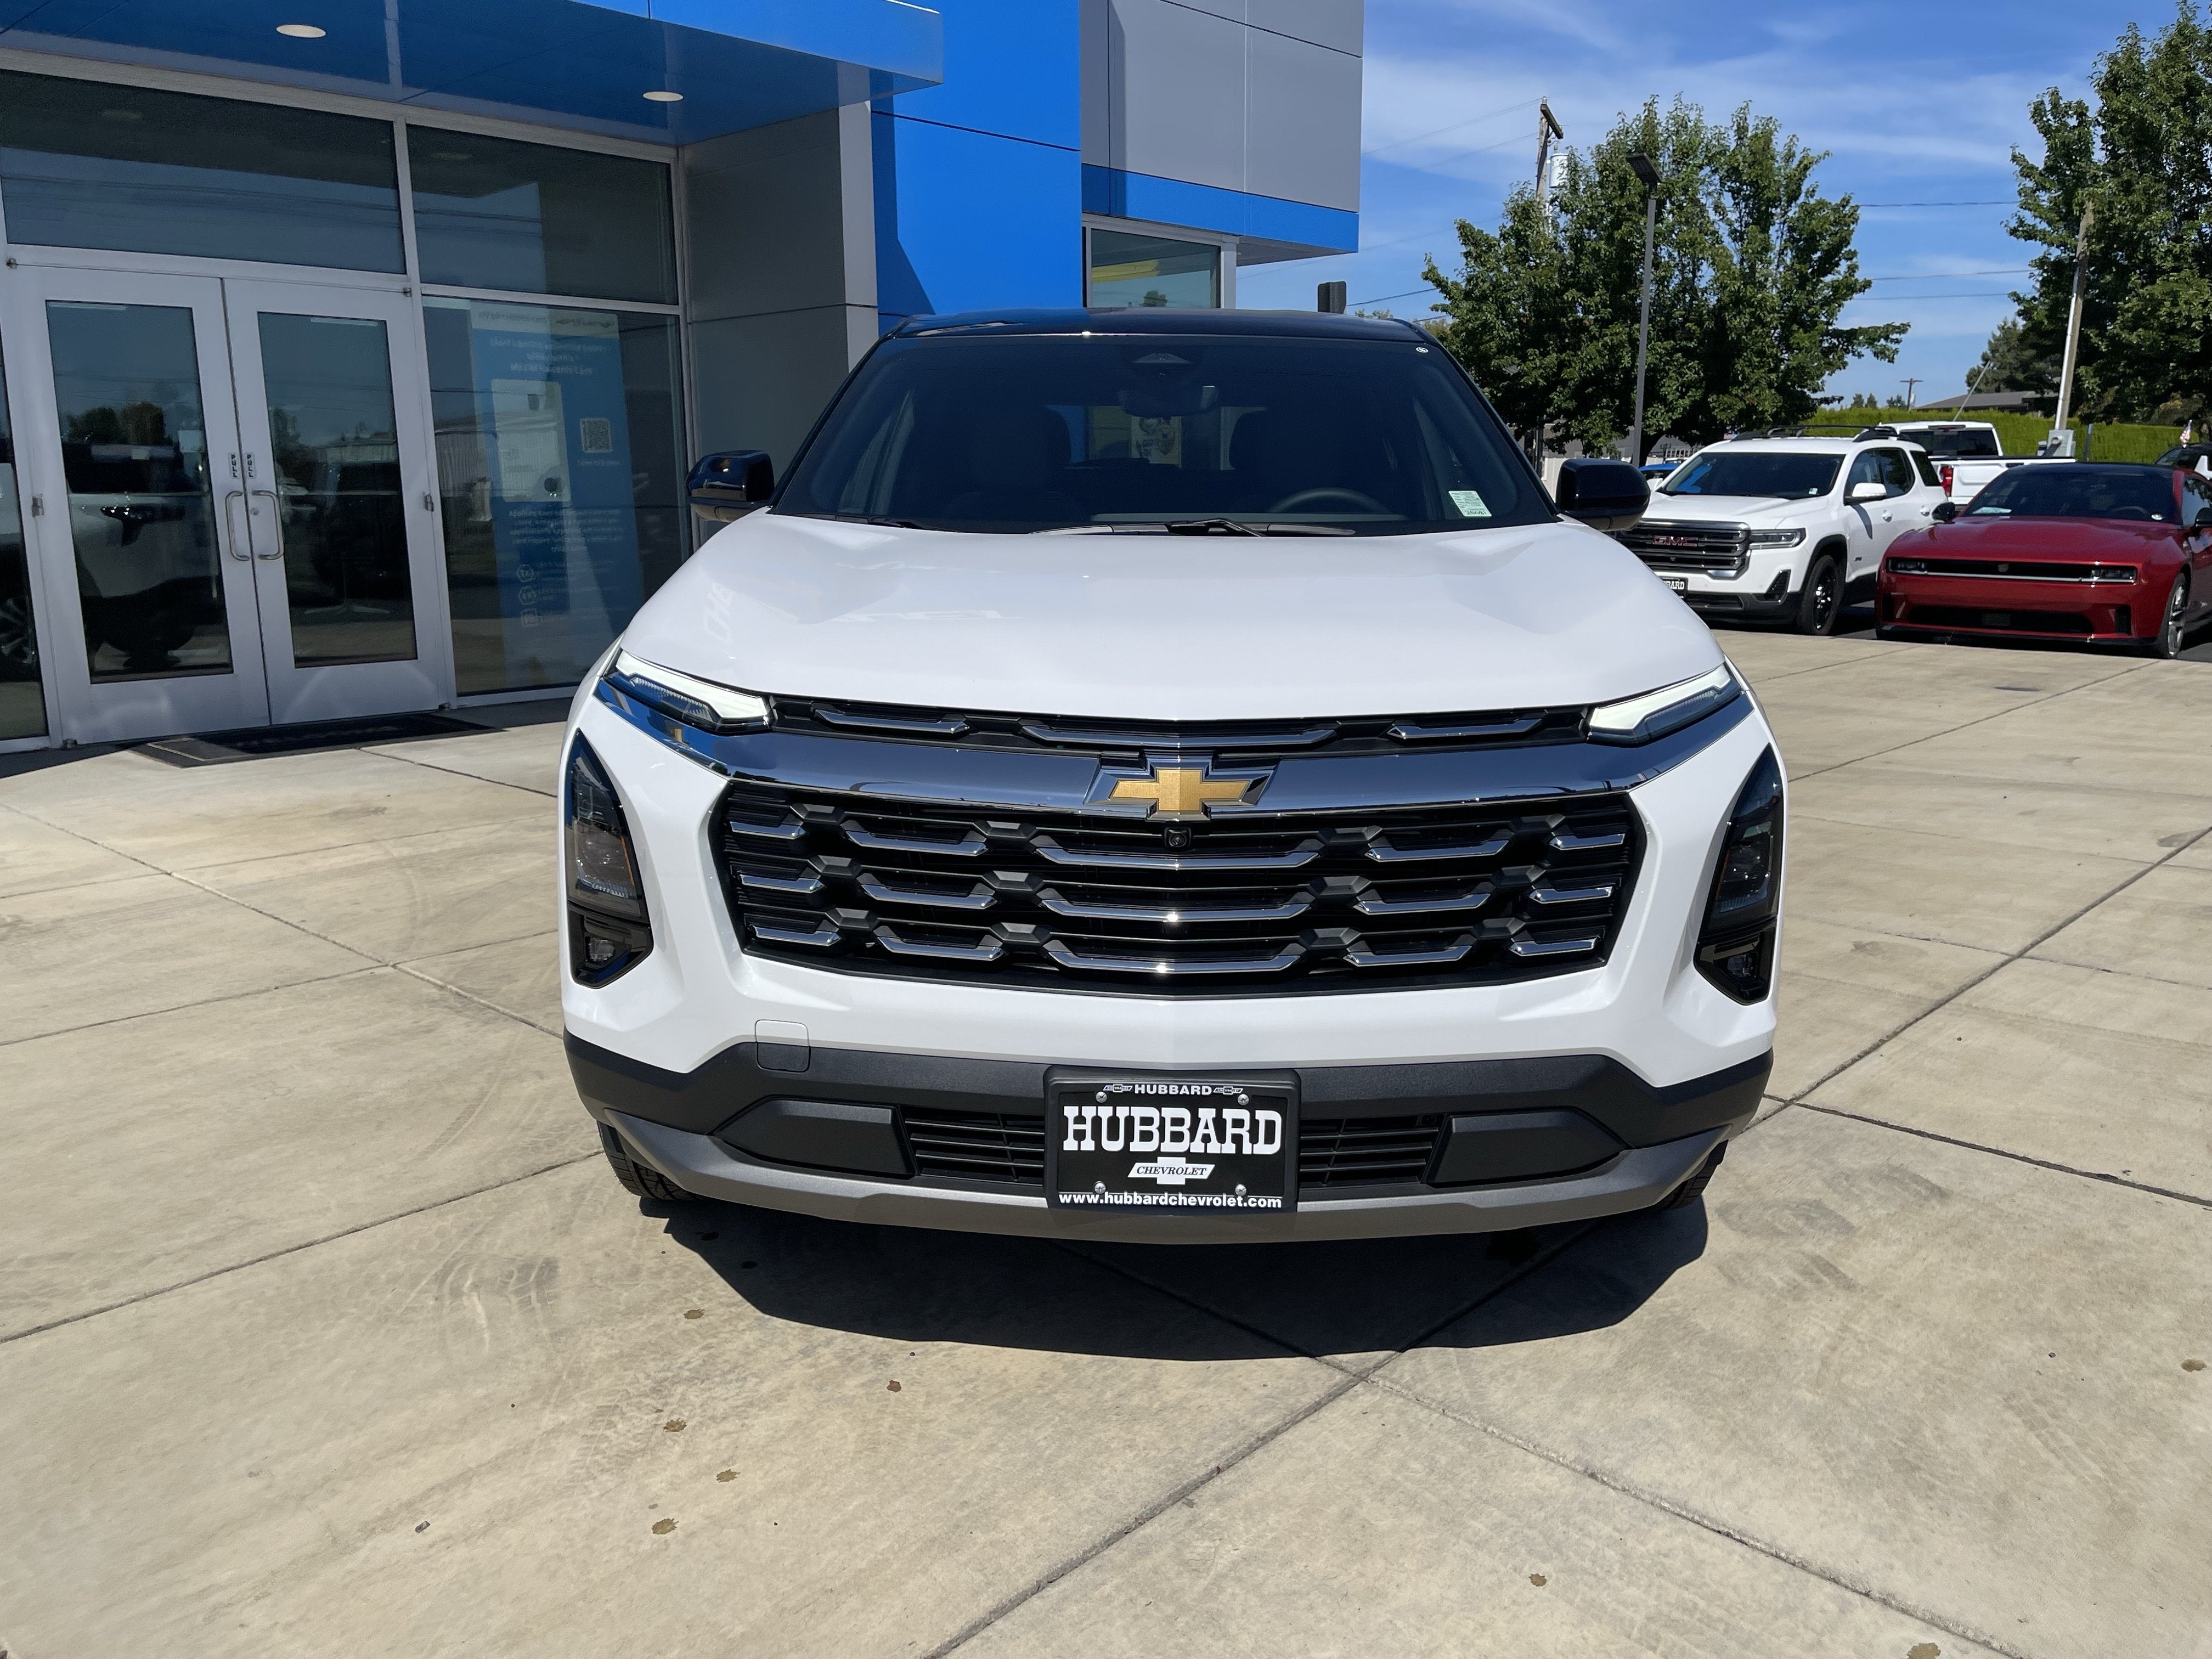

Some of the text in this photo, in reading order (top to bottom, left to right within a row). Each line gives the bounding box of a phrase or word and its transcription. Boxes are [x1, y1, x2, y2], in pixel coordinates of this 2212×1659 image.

[1651, 535, 1699, 547] GMC
[1135, 1084, 1212, 1096] HUBBARD
[1063, 1105, 1283, 1155] HUBBARD
[1136, 1166, 1207, 1177] CHEVROLET
[1058, 1190, 1282, 1208] www.hubbardchevrolet.com
